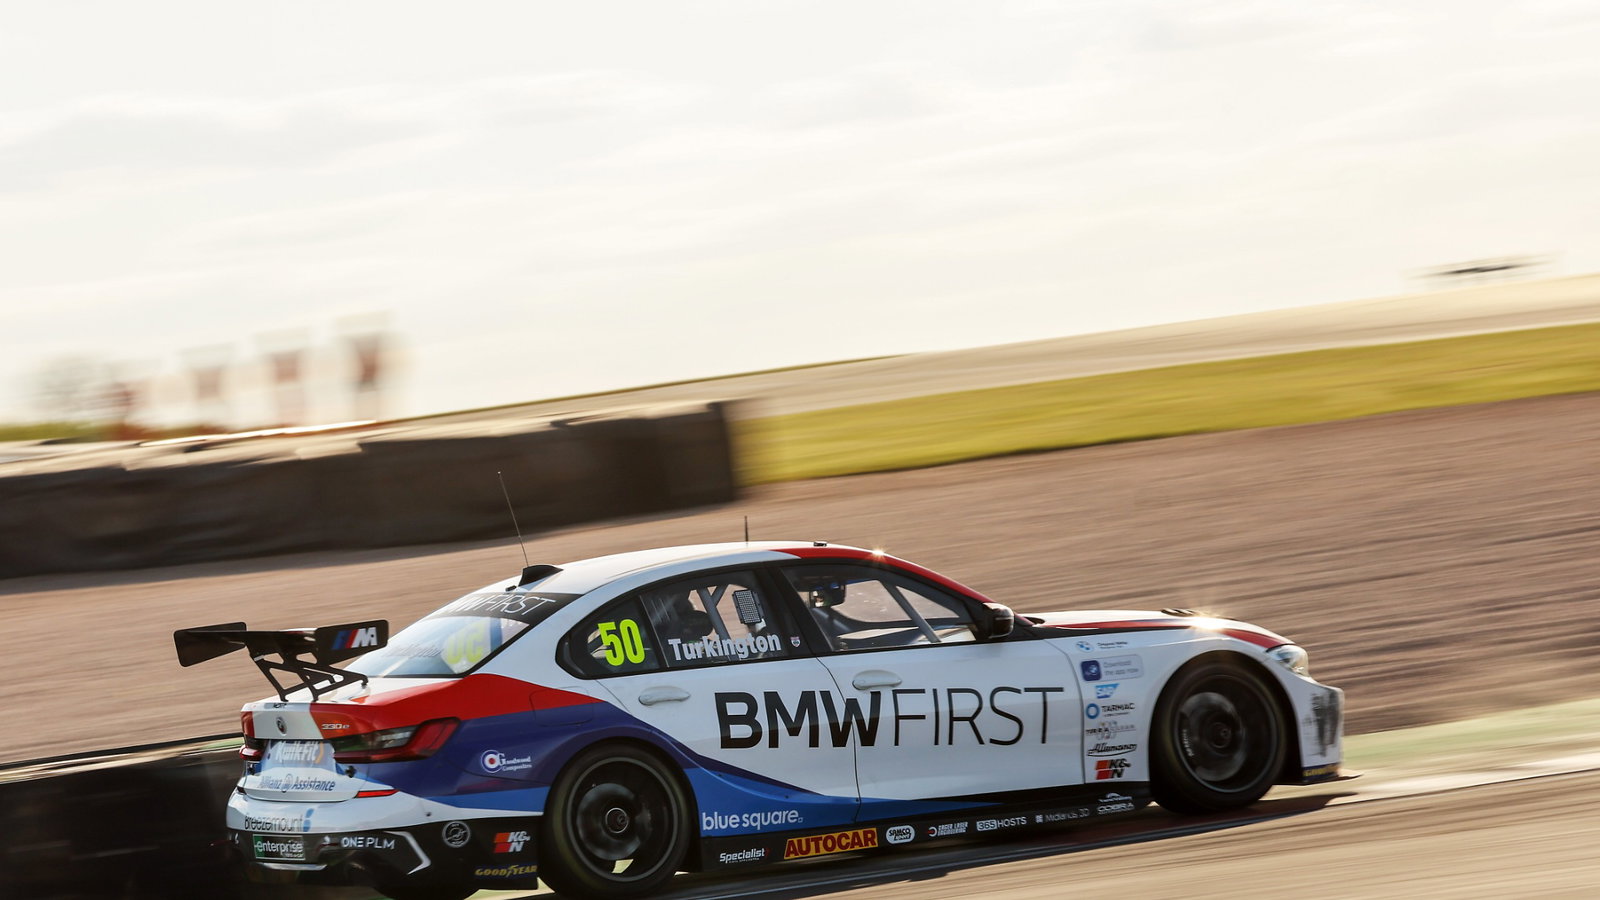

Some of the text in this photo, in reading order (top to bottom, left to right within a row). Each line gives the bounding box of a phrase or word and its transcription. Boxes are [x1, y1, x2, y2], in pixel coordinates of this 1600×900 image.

[598, 618, 646, 666] 50
[667, 633, 782, 661] Turkington
[1101, 703, 1136, 713] TARMAC
[291, 776, 336, 791] Assistance
[702, 809, 799, 831] blue square
[254, 839, 304, 856] enterprise
[340, 836, 396, 850] ONE PLM
[784, 829, 877, 858] AUTOCAR
[719, 847, 766, 864] Specialist
[475, 864, 538, 877] GOODYEAR
